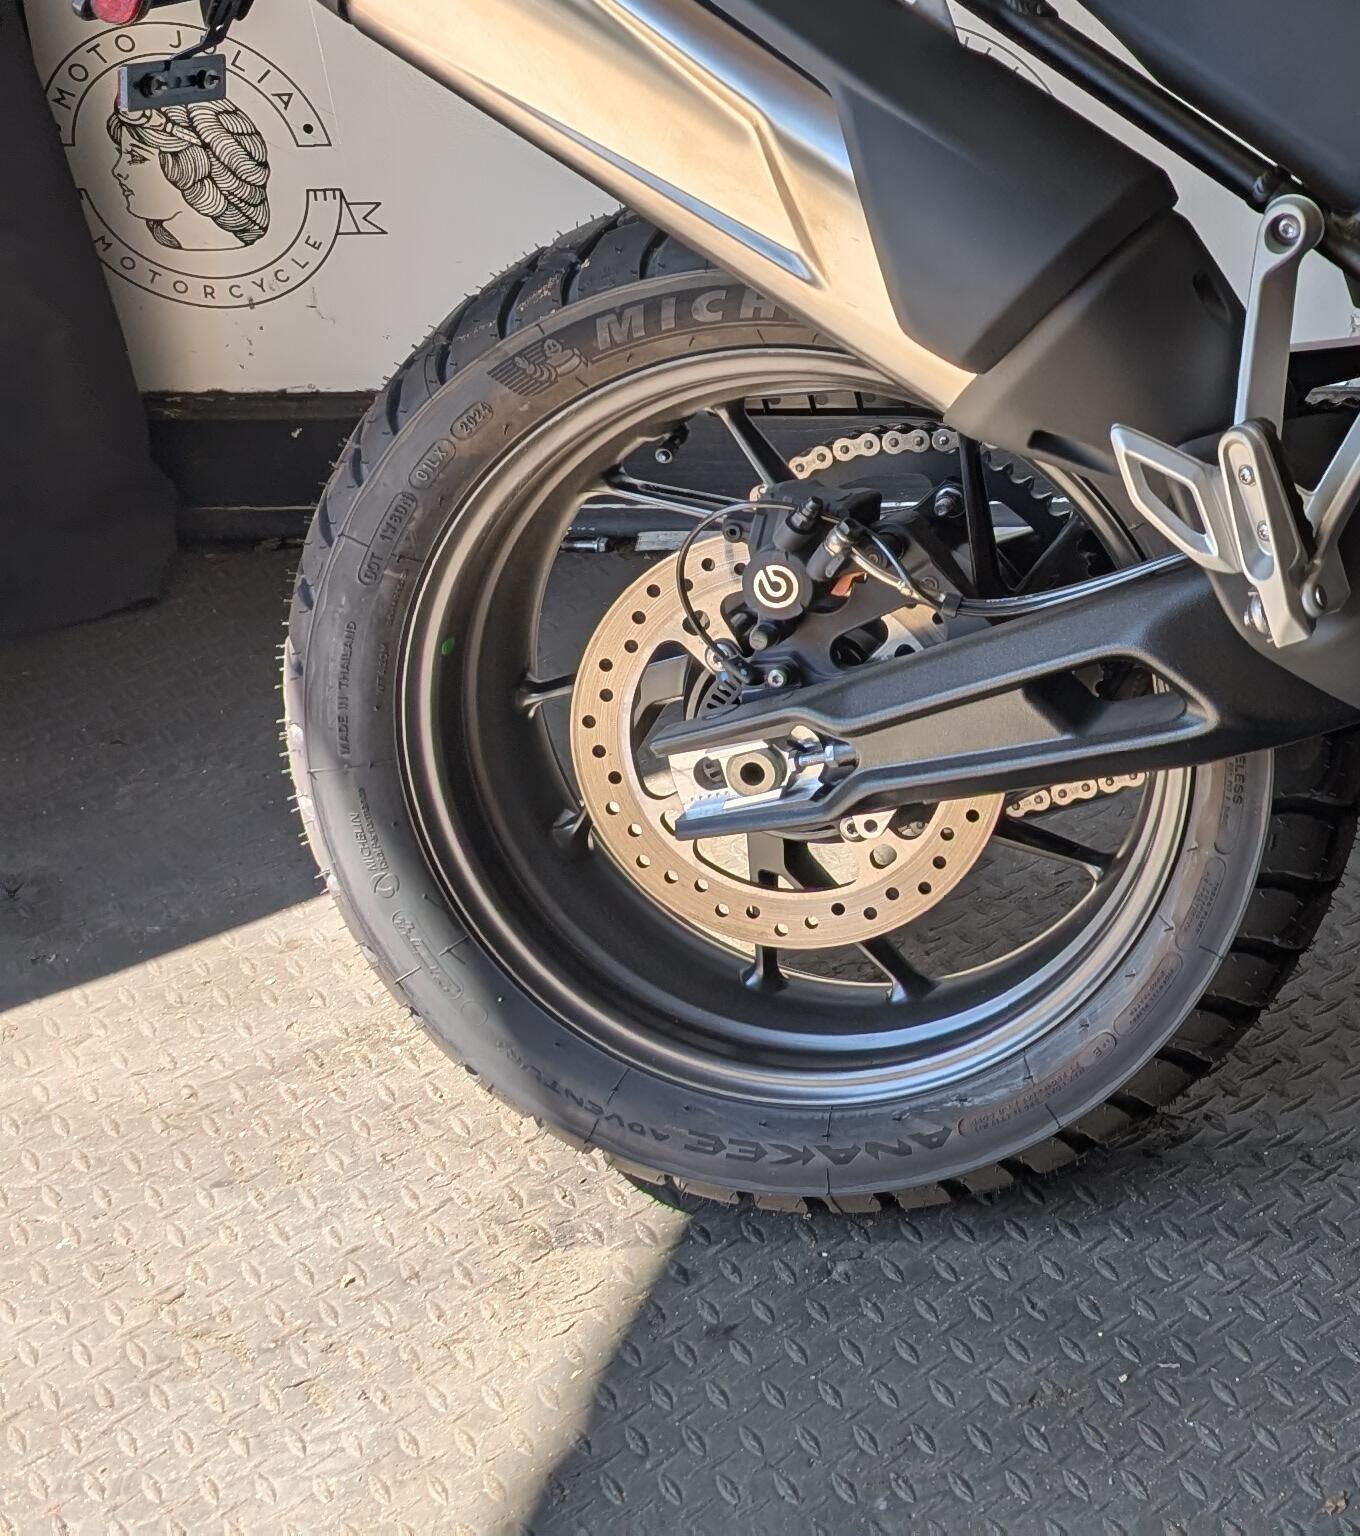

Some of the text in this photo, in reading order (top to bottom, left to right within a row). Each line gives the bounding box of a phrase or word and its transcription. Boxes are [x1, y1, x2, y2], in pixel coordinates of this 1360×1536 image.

[51, 30, 294, 111] MOTO JLIA
[93, 234, 323, 299] MOTORCYCLE
[596, 286, 782, 350] MICH
[338, 620, 356, 757] MADE IN THAILAND
[1232, 755, 1246, 805] ELESS
[351, 811, 377, 874] MICHELIN
[683, 1125, 953, 1166] ANAKEE
